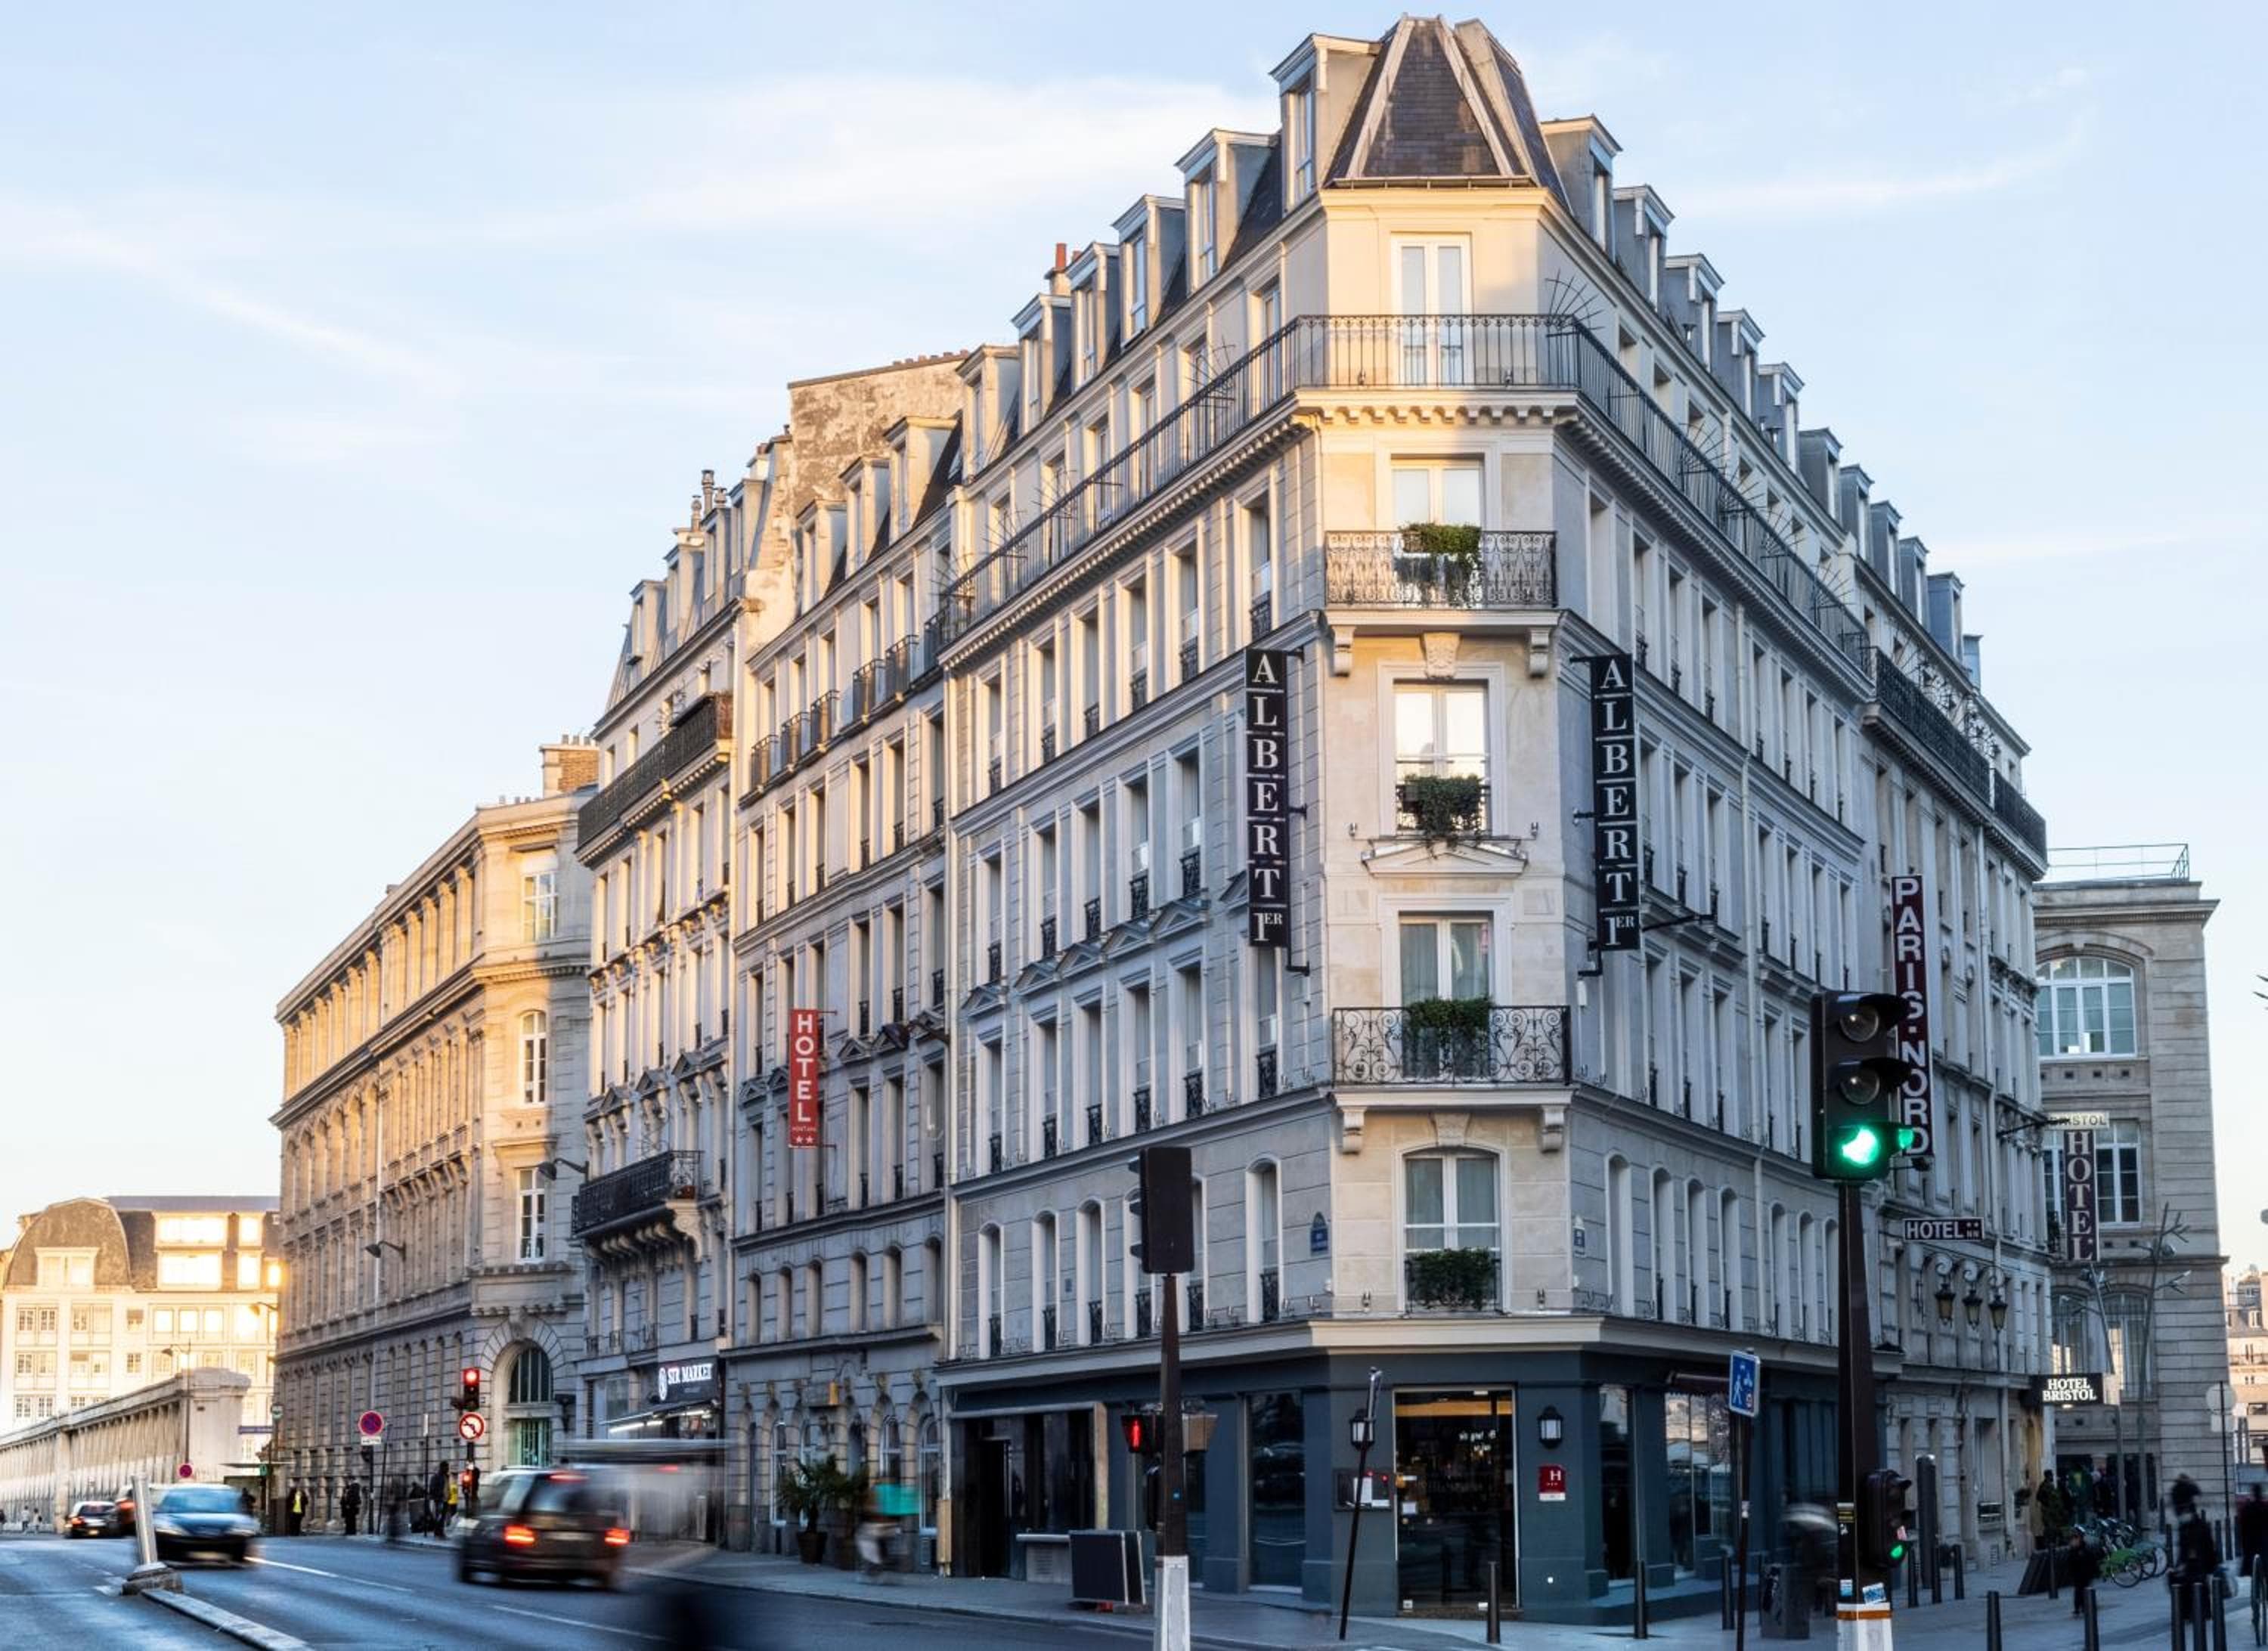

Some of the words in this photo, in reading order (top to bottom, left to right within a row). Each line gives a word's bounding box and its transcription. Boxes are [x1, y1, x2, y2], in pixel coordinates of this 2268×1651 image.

[1252, 653, 1281, 899] ALBERT
[1600, 658, 1632, 903] ALBERT
[795, 1014, 814, 1122] HOTEL
[2067, 1131, 2093, 1261] HOTEL
[1907, 1221, 1965, 1239] HOTEL
[2043, 1389, 2097, 1402] BRISTOL
[2047, 1377, 2090, 1389] HOTEL
[1551, 1470, 1561, 1481] H
